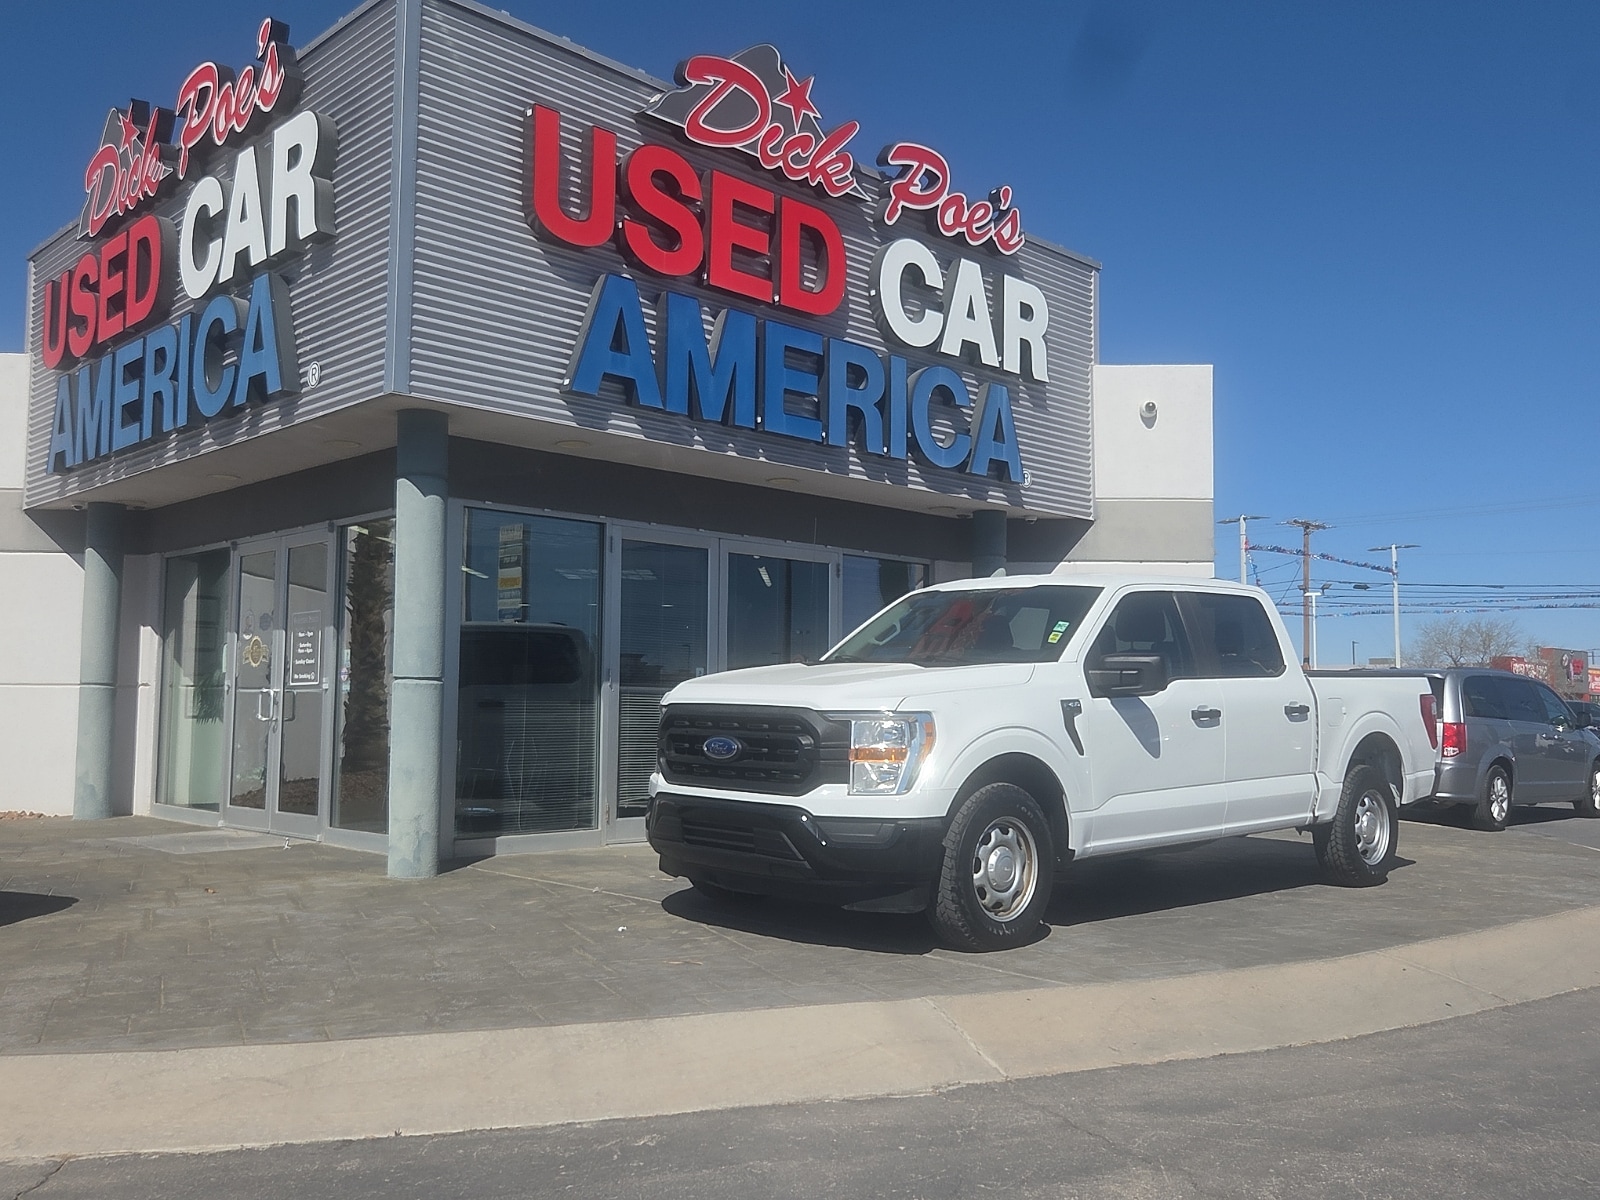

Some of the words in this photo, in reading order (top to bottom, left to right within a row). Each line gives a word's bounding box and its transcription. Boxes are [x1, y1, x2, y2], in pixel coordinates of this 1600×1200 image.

[85, 106, 162, 238] Dick
[175, 16, 286, 180] Poe's
[684, 54, 861, 197] Dick
[883, 142, 1025, 255] Poe's
[43, 214, 162, 370] USED
[180, 110, 320, 299] CAR
[531, 103, 848, 316] USED
[878, 237, 1050, 383] CAR
[47, 273, 282, 475] AMERICA
[570, 274, 1024, 483] AMERICA
